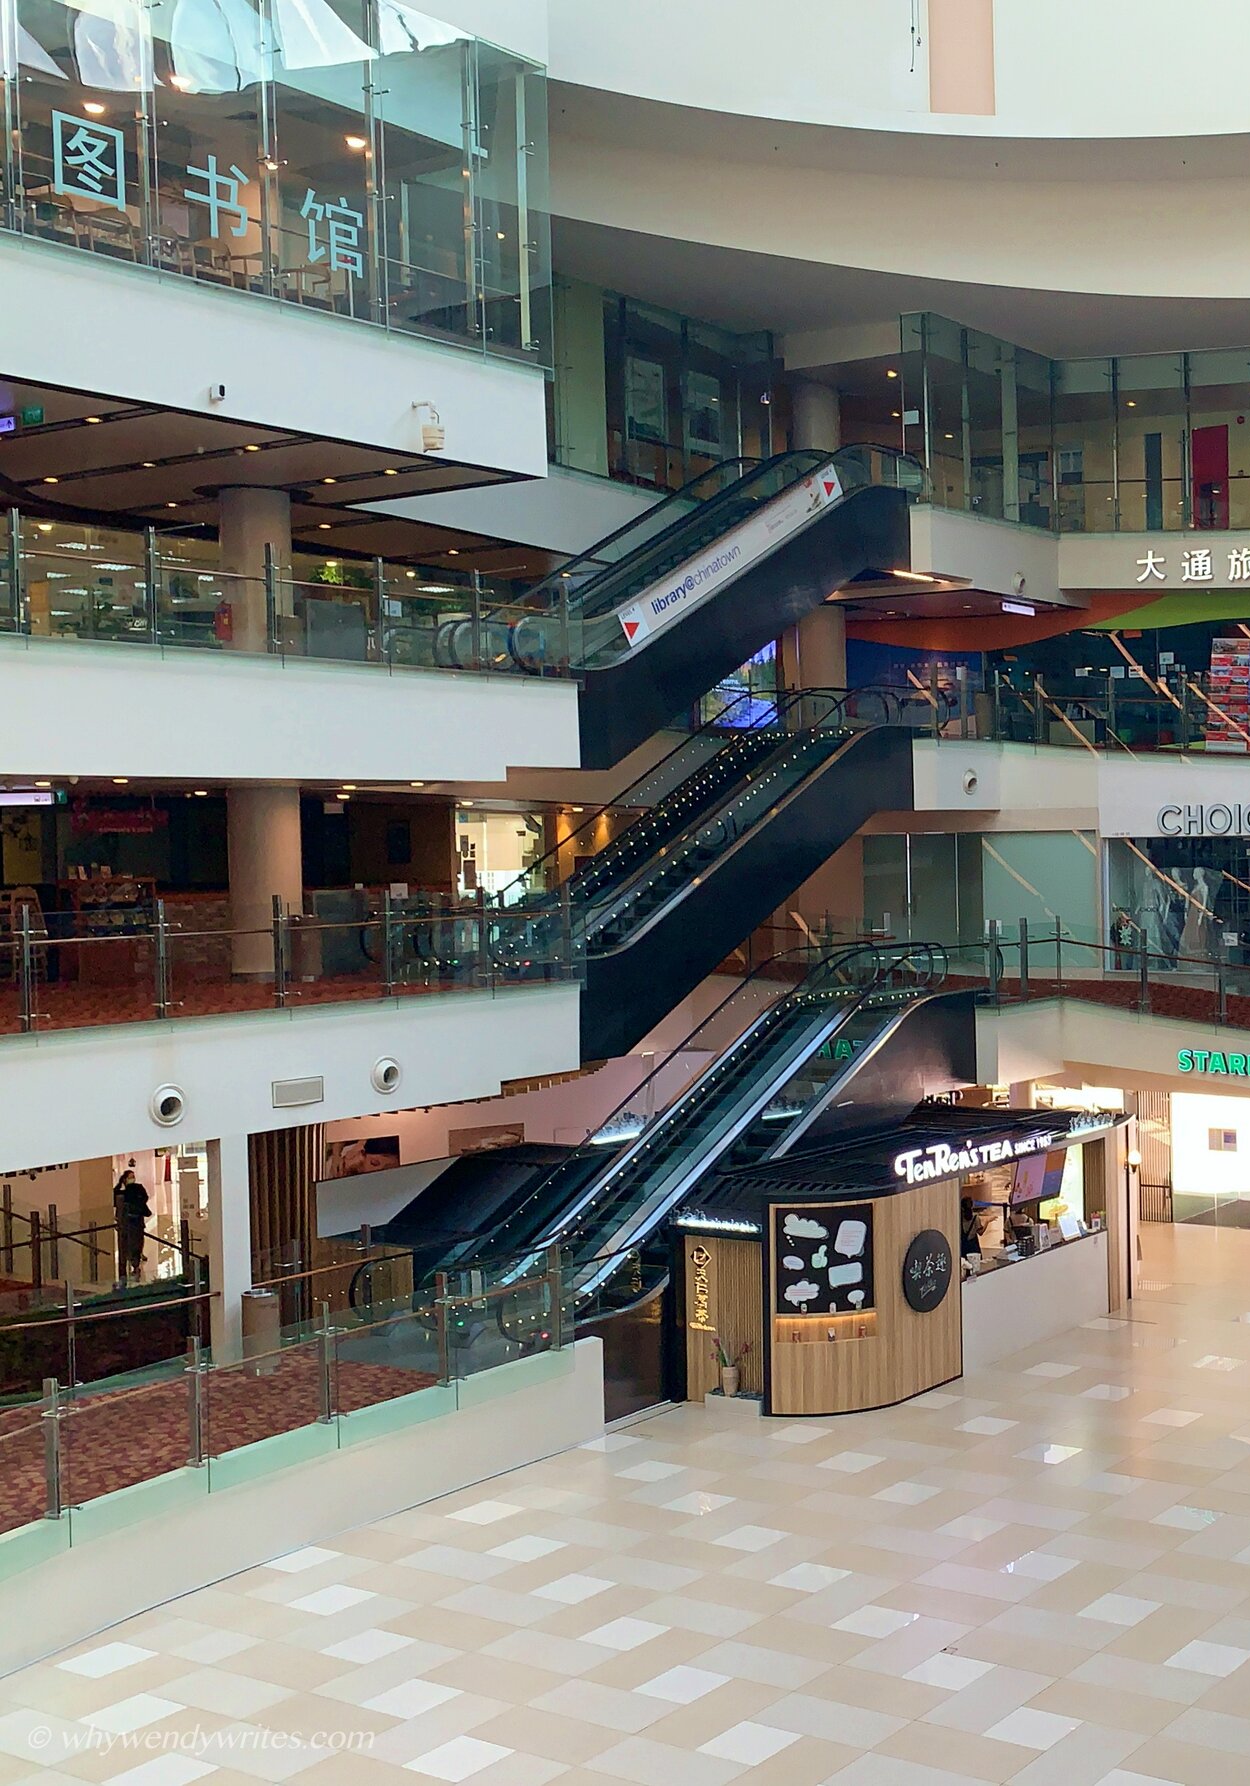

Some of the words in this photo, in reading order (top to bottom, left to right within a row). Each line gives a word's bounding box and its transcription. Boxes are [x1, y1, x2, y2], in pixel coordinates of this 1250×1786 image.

[52, 110, 363, 279] 图书馆
[651, 544, 742, 615] library@chinatown
[980, 1139, 1014, 1163] TEA
